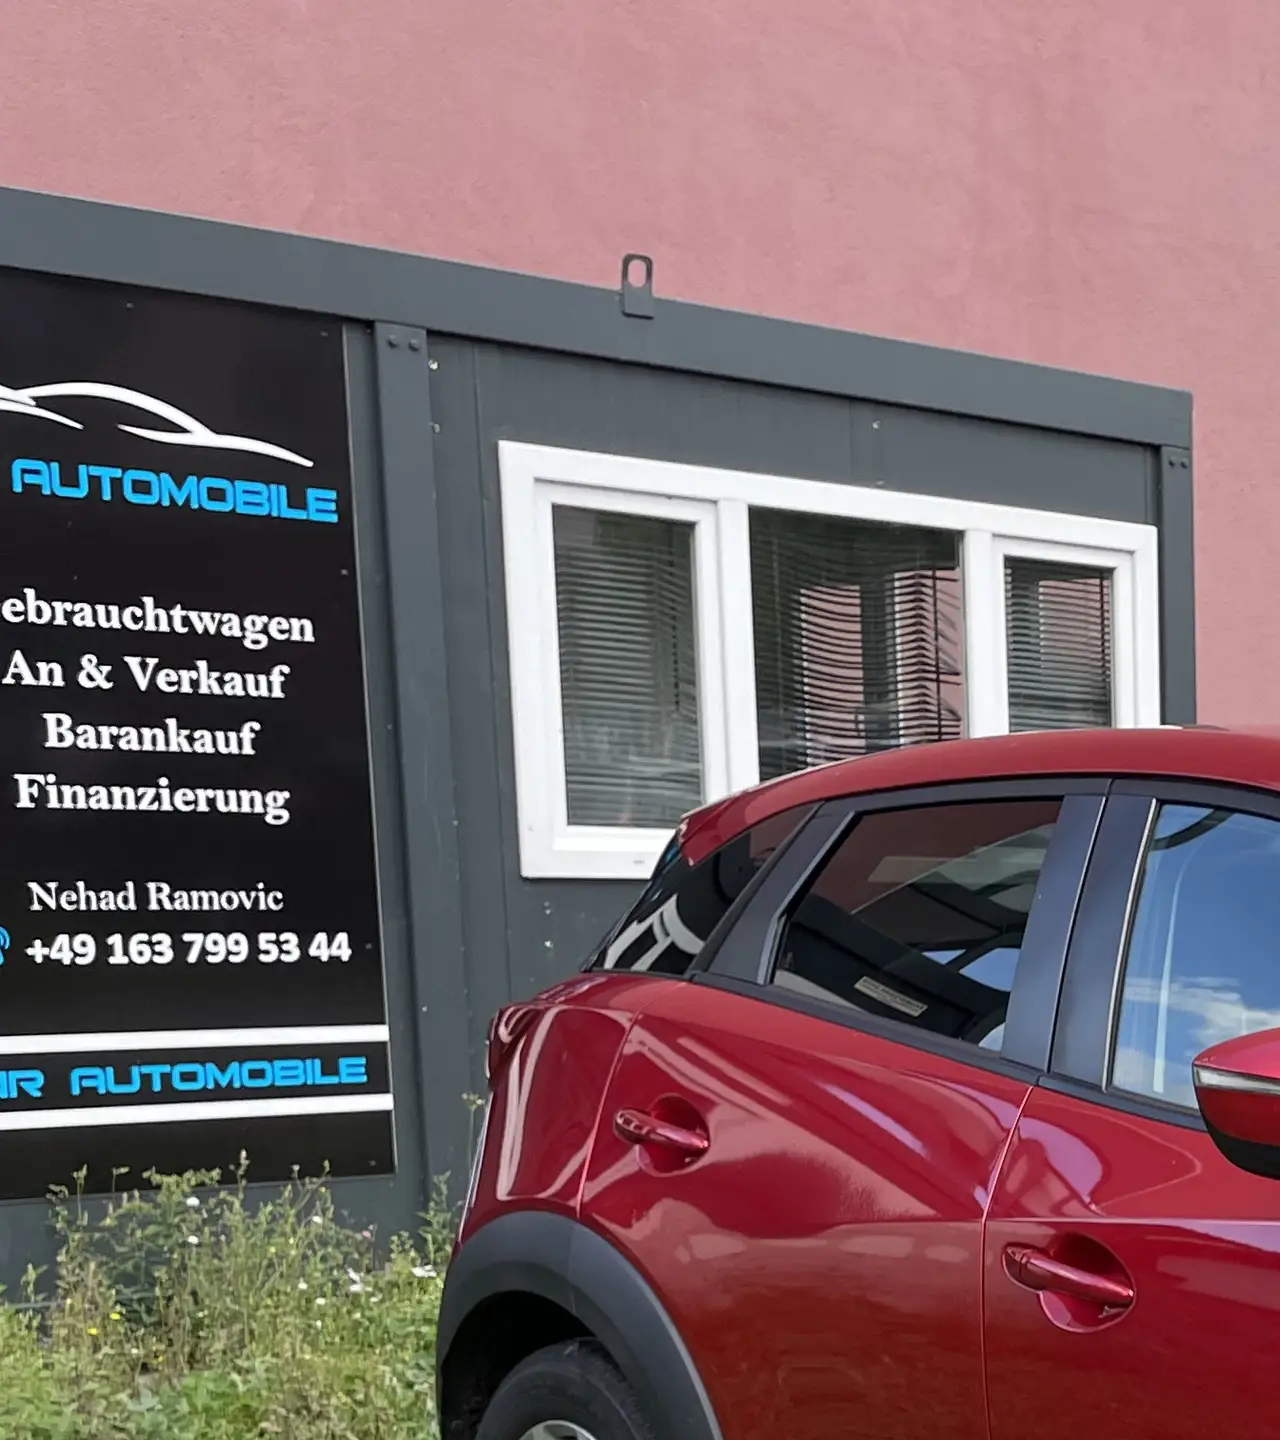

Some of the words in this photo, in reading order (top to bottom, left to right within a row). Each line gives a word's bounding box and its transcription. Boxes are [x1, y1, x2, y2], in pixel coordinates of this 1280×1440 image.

[12, 459, 338, 523] AUTOMOBILE
[2, 588, 315, 650] ebrauchtwagen
[2, 649, 65, 687] An
[78, 654, 113, 690] &
[123, 656, 291, 699] Verkauf
[42, 713, 261, 756] Barankauf
[13, 773, 291, 825] Finanzierung
[28, 881, 137, 911] Nehad
[146, 882, 284, 911] Ramovic
[25, 933, 96, 965] +49
[106, 932, 173, 964] 163
[182, 932, 249, 964] 799
[258, 932, 301, 963] 53
[308, 931, 352, 962] 44
[70, 1056, 367, 1096] AUTOMOBILE
